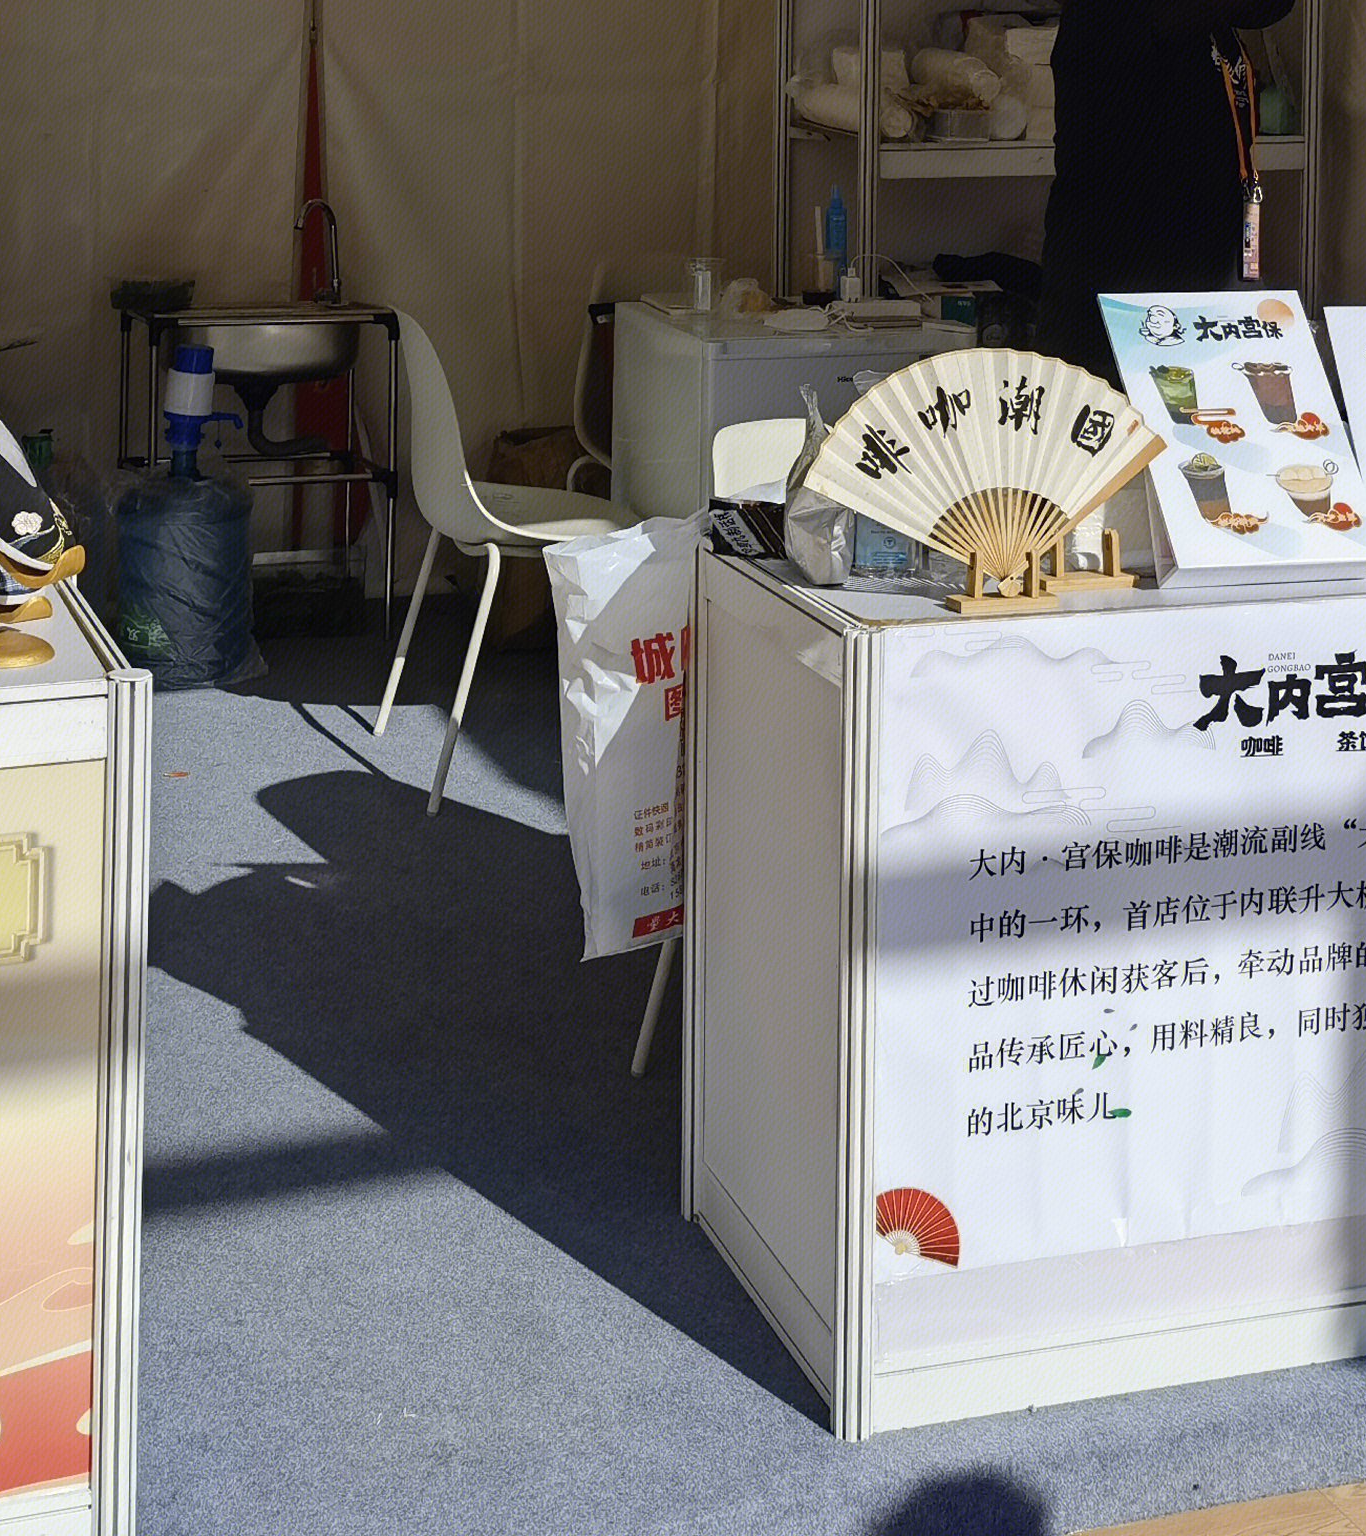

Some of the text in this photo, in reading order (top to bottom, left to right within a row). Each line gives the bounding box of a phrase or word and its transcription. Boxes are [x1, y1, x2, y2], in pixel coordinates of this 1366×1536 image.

[1192, 315, 1284, 342] 大内宫保
[630, 624, 691, 684] 城
[1267, 651, 1297, 662] DANEI
[1266, 663, 1312, 673] GONGBAO
[1241, 735, 1283, 756] 咖啡
[966, 1091, 1118, 1137] 的北京味儿
